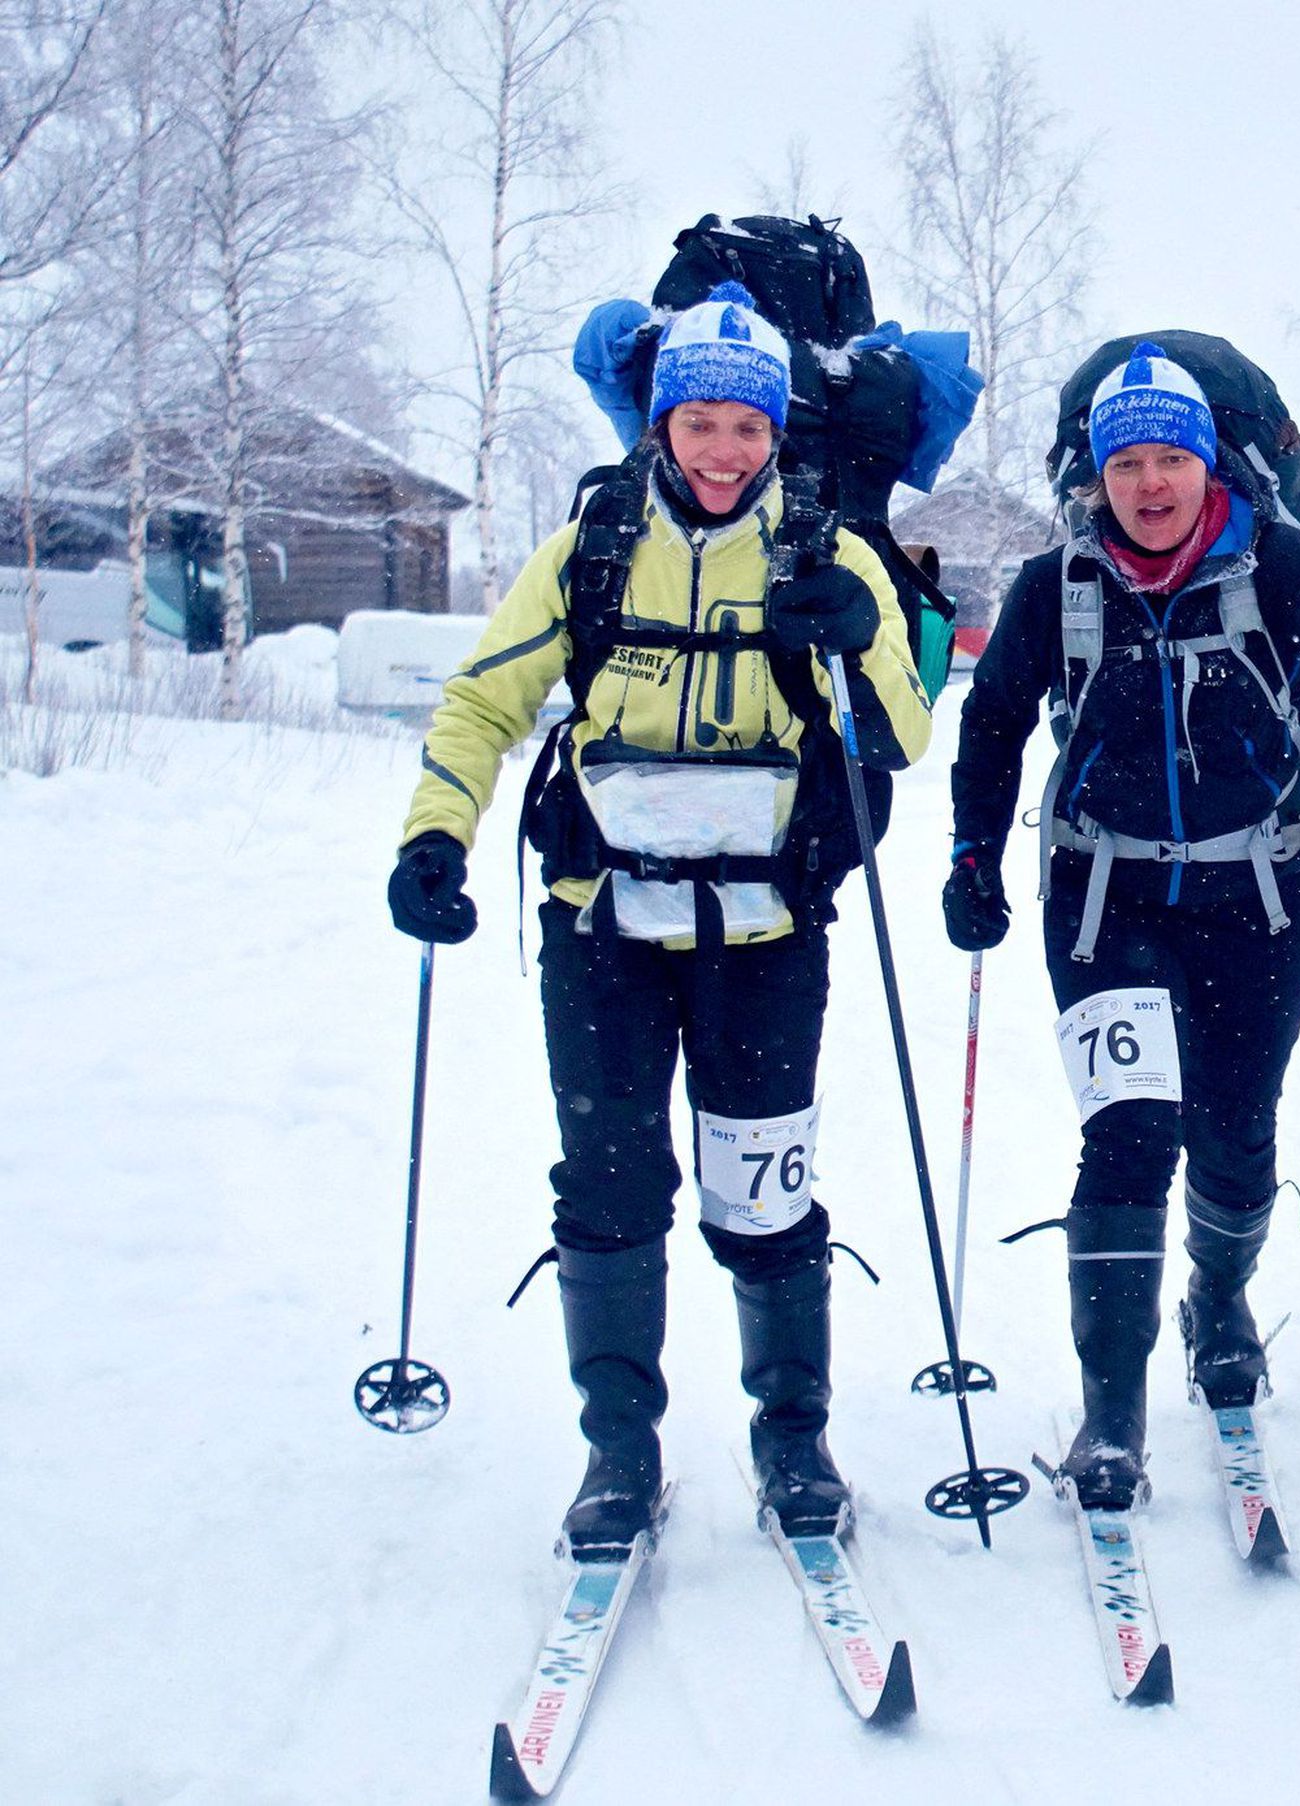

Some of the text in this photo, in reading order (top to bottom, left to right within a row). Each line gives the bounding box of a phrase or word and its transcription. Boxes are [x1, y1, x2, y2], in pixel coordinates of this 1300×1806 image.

[1133, 1002, 1161, 1012] 2017
[1078, 1020, 1141, 1078] 76
[710, 1128, 737, 1143] 2017
[741, 1144, 805, 1200] 76
